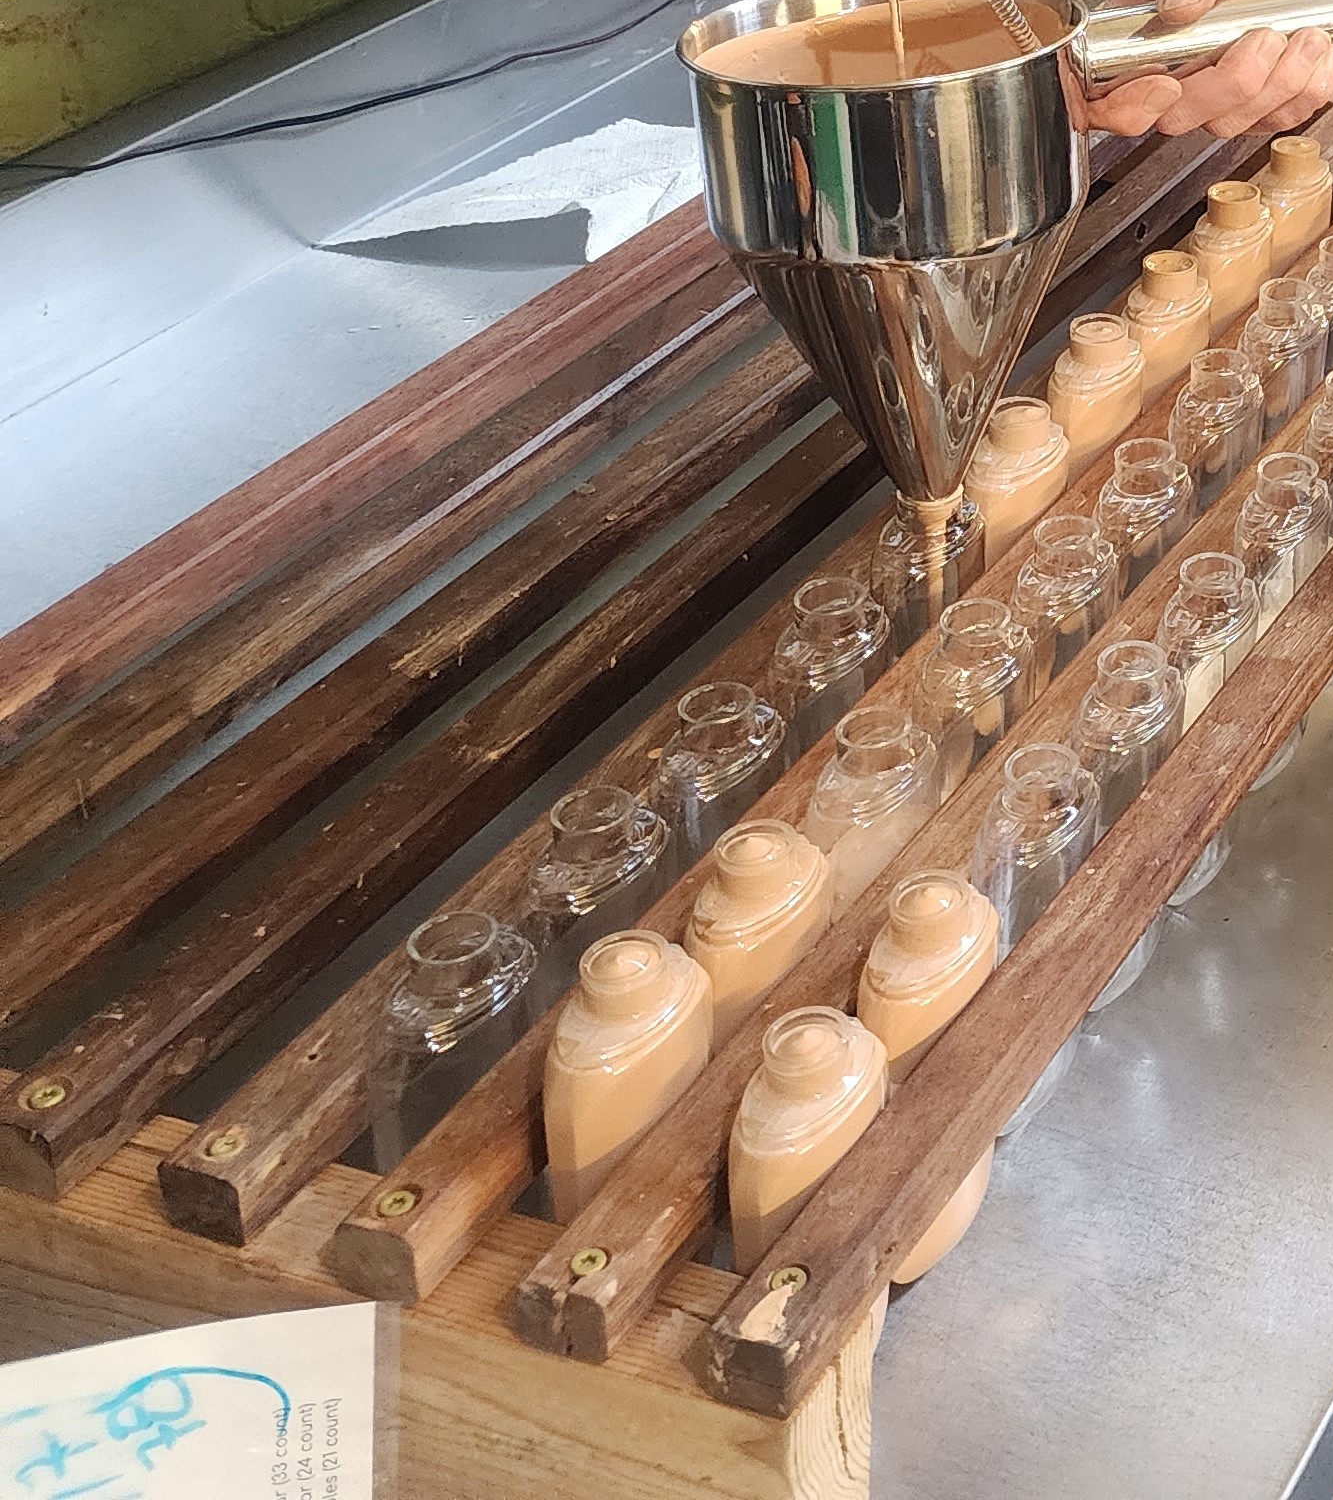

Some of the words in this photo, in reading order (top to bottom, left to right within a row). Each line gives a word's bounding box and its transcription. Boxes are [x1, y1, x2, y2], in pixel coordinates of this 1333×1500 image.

[298, 1403, 317, 1452] count)
[323, 1398, 342, 1447] count)
[296, 1457, 316, 1481] (24
[322, 1451, 342, 1471] (21
[271, 1462, 291, 1485] (33
